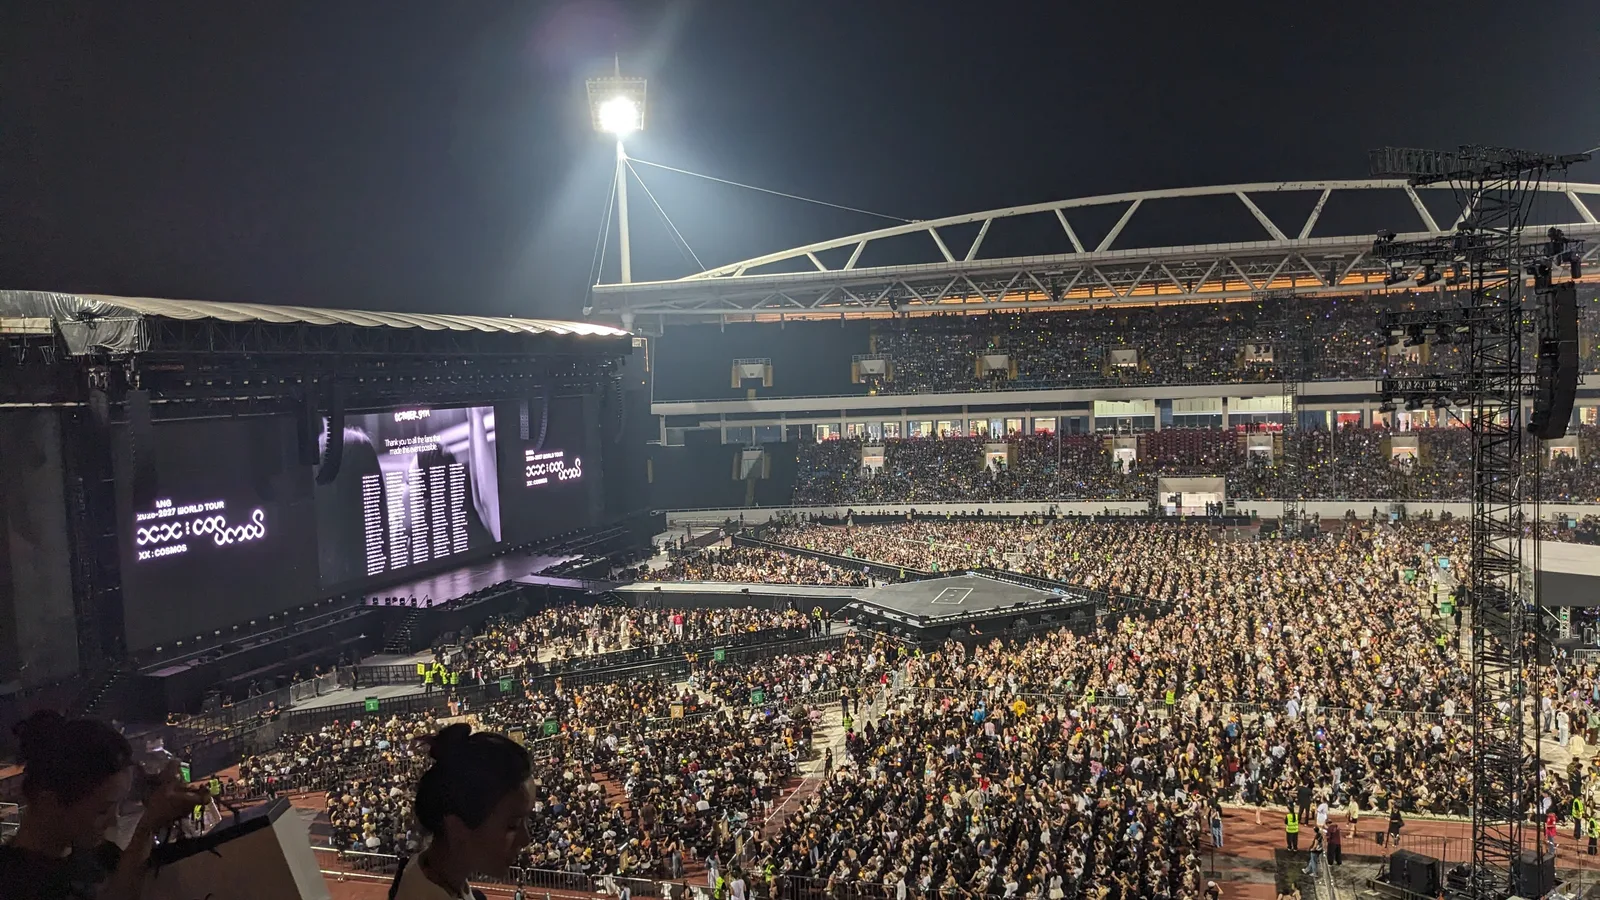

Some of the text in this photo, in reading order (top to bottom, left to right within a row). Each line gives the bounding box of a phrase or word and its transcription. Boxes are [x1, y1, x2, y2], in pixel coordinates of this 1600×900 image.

[384, 438, 398, 446] Thank
[390, 446, 402, 455] made
[177, 505, 204, 515] WORLD
[204, 501, 224, 511] TOUR
